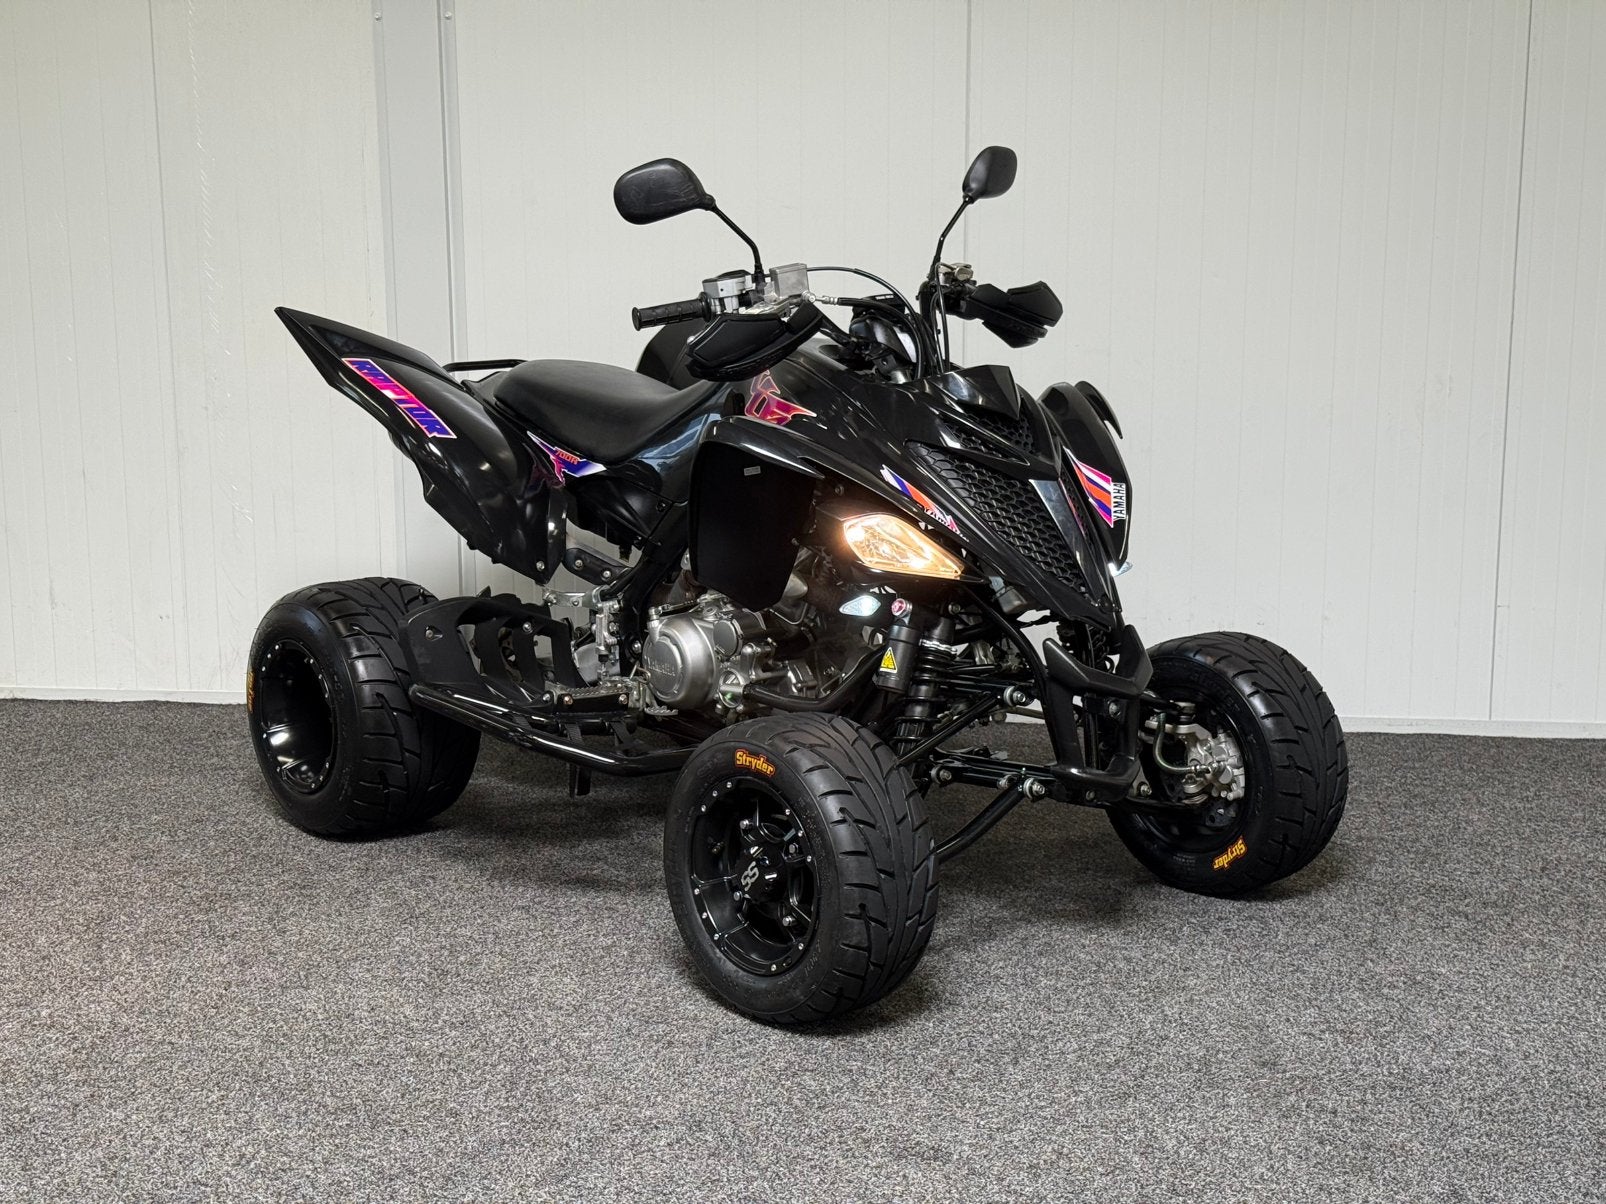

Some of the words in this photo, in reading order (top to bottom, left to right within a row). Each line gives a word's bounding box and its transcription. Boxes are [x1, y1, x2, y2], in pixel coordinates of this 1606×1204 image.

[1112, 482, 1126, 520] YAMAHA
[735, 749, 776, 776] Stryder
[1212, 836, 1247, 870] Stryder
